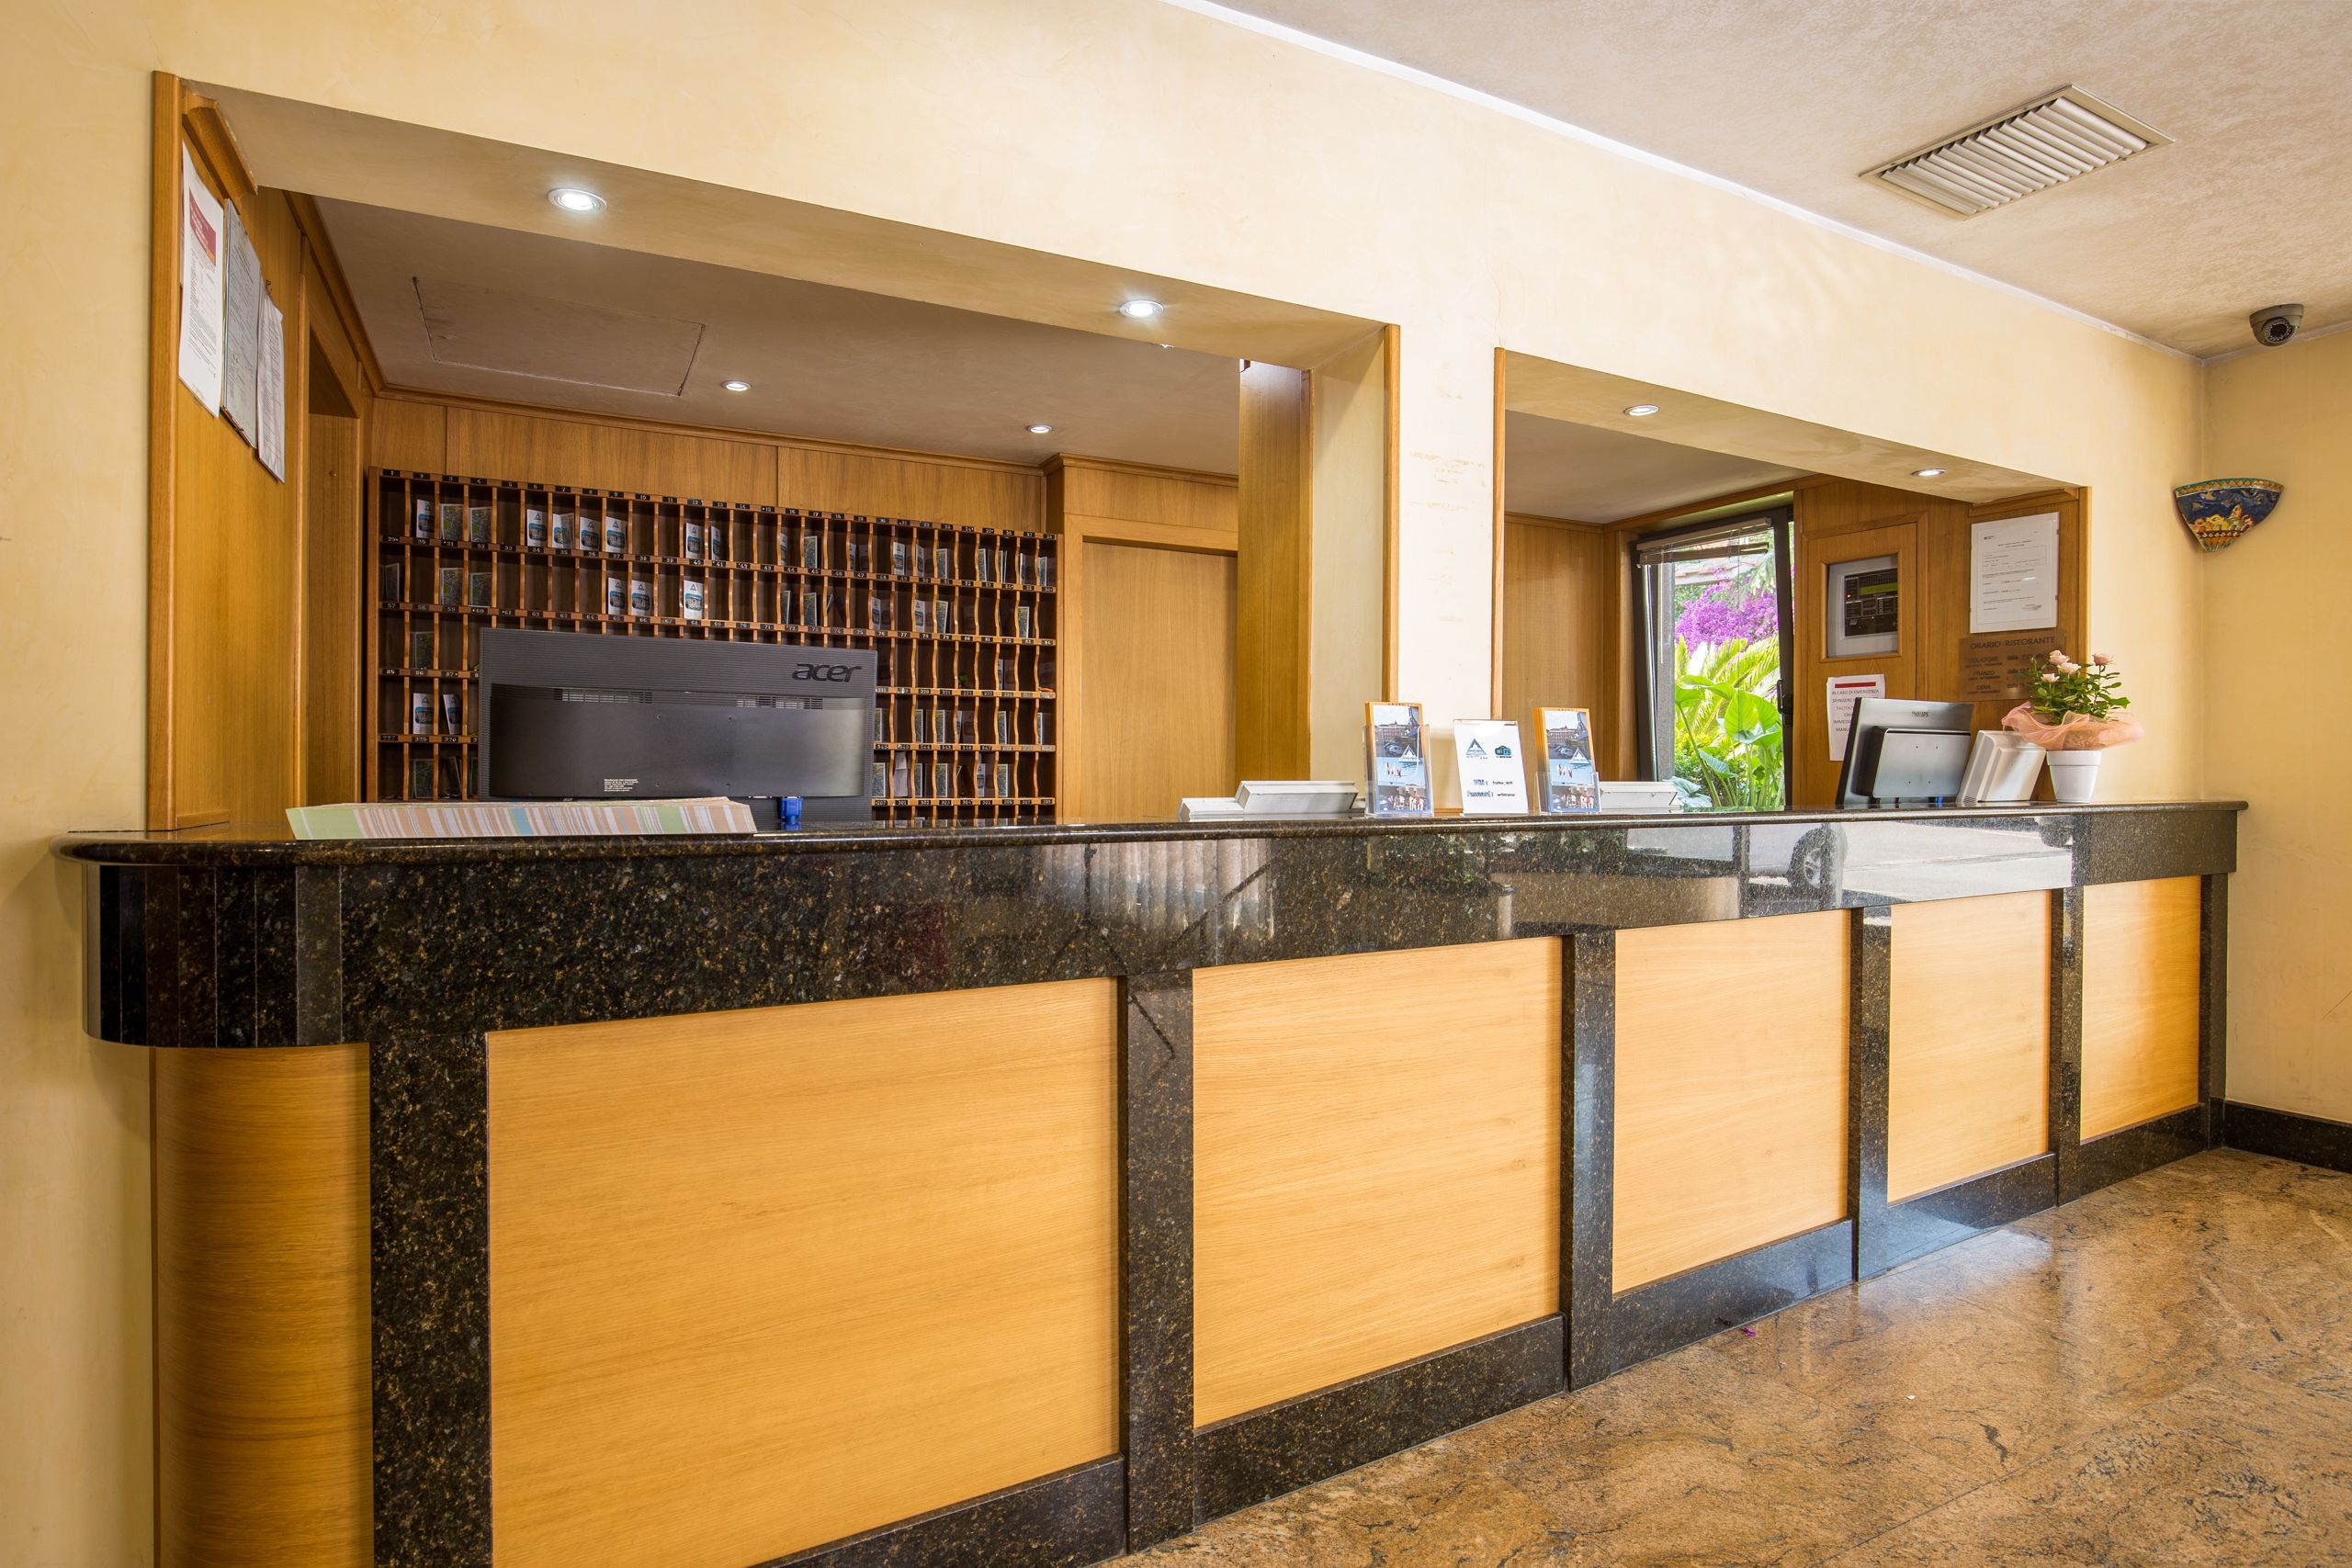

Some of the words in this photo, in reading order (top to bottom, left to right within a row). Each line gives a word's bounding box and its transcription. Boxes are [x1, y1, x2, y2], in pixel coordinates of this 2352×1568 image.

[1970, 641, 2001, 649] ORARIO
[2006, 636, 2055, 646] RISTORANTE
[792, 663, 862, 682] acer
